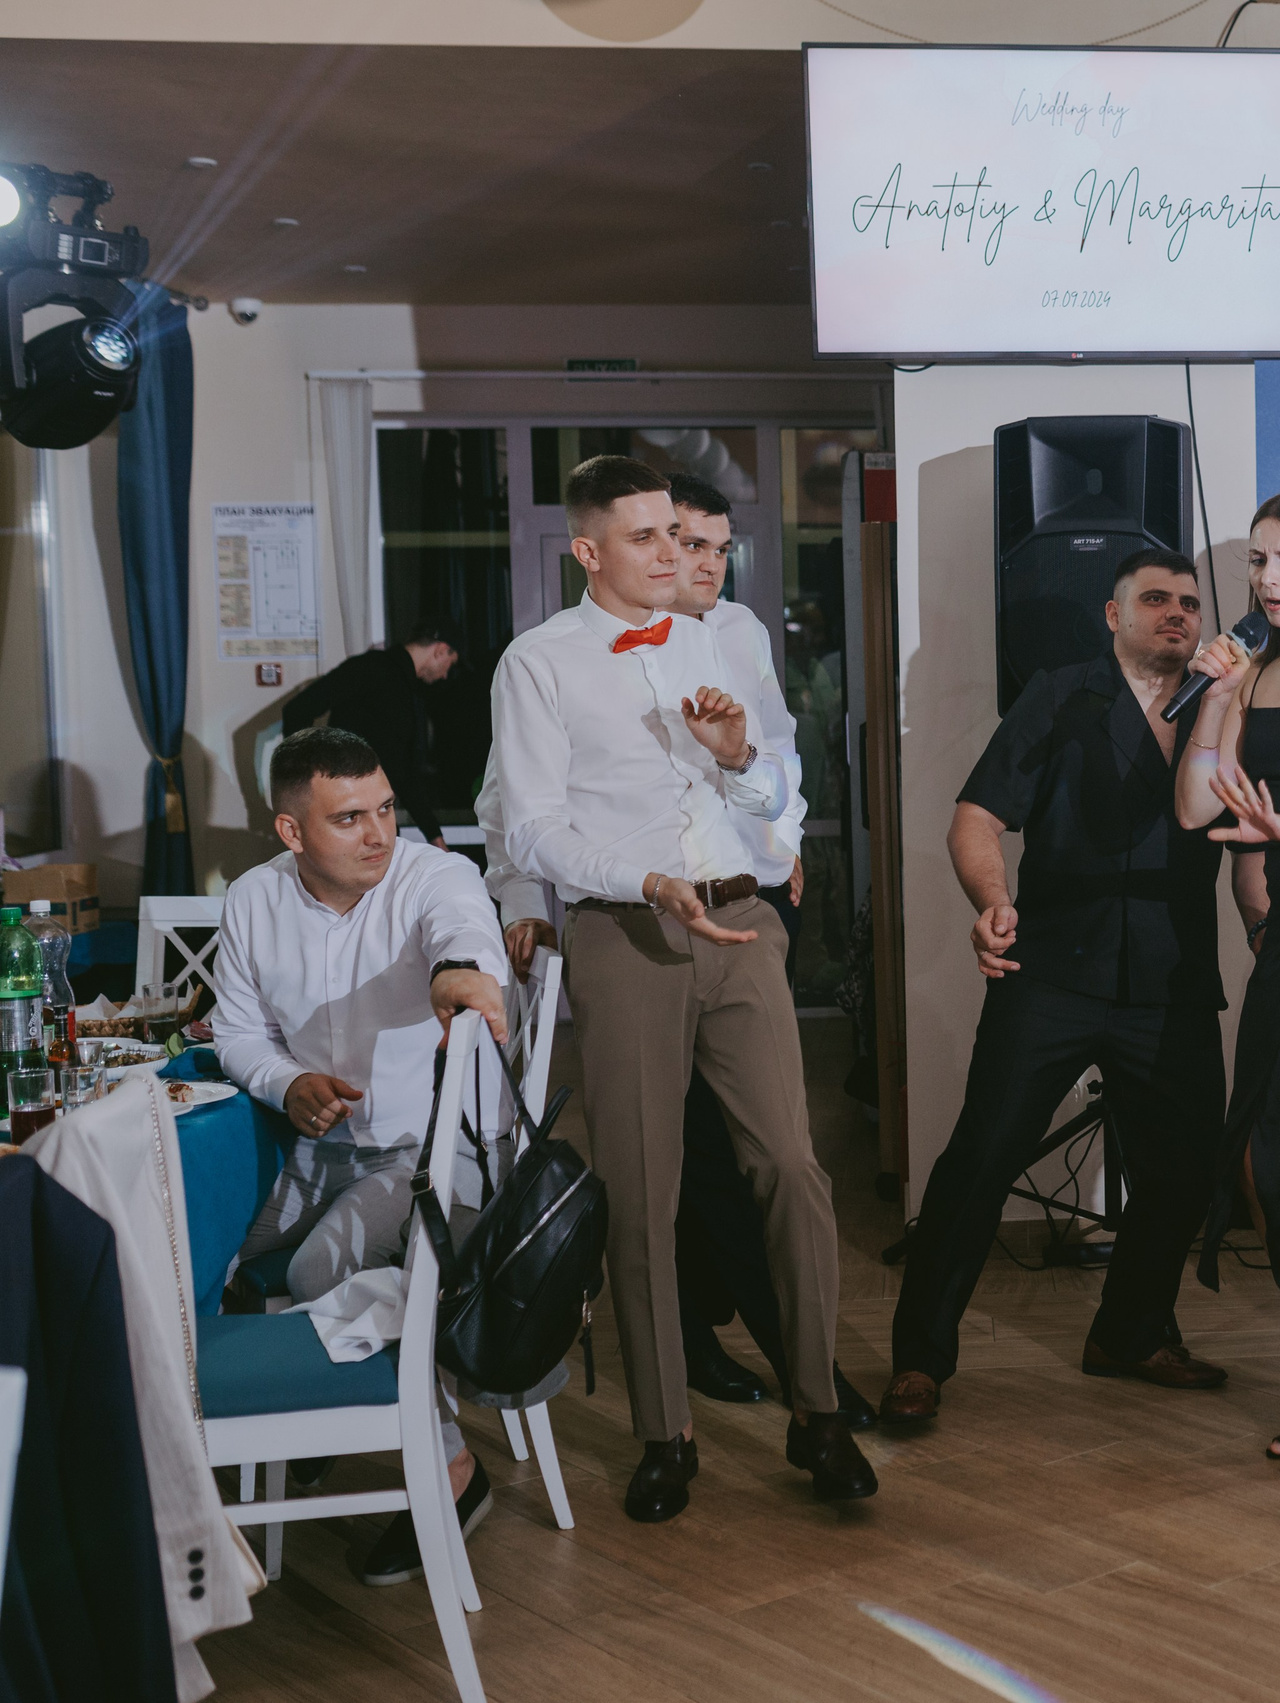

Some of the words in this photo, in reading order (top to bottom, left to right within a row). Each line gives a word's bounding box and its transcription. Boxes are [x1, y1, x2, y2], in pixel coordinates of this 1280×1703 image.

[1011, 88, 1094, 136] Wedding
[1098, 91, 1131, 139] day
[852, 162, 1020, 267] Anatoliy
[1033, 189, 1057, 224] &
[1041, 289, 1112, 308] 07.09.2024
